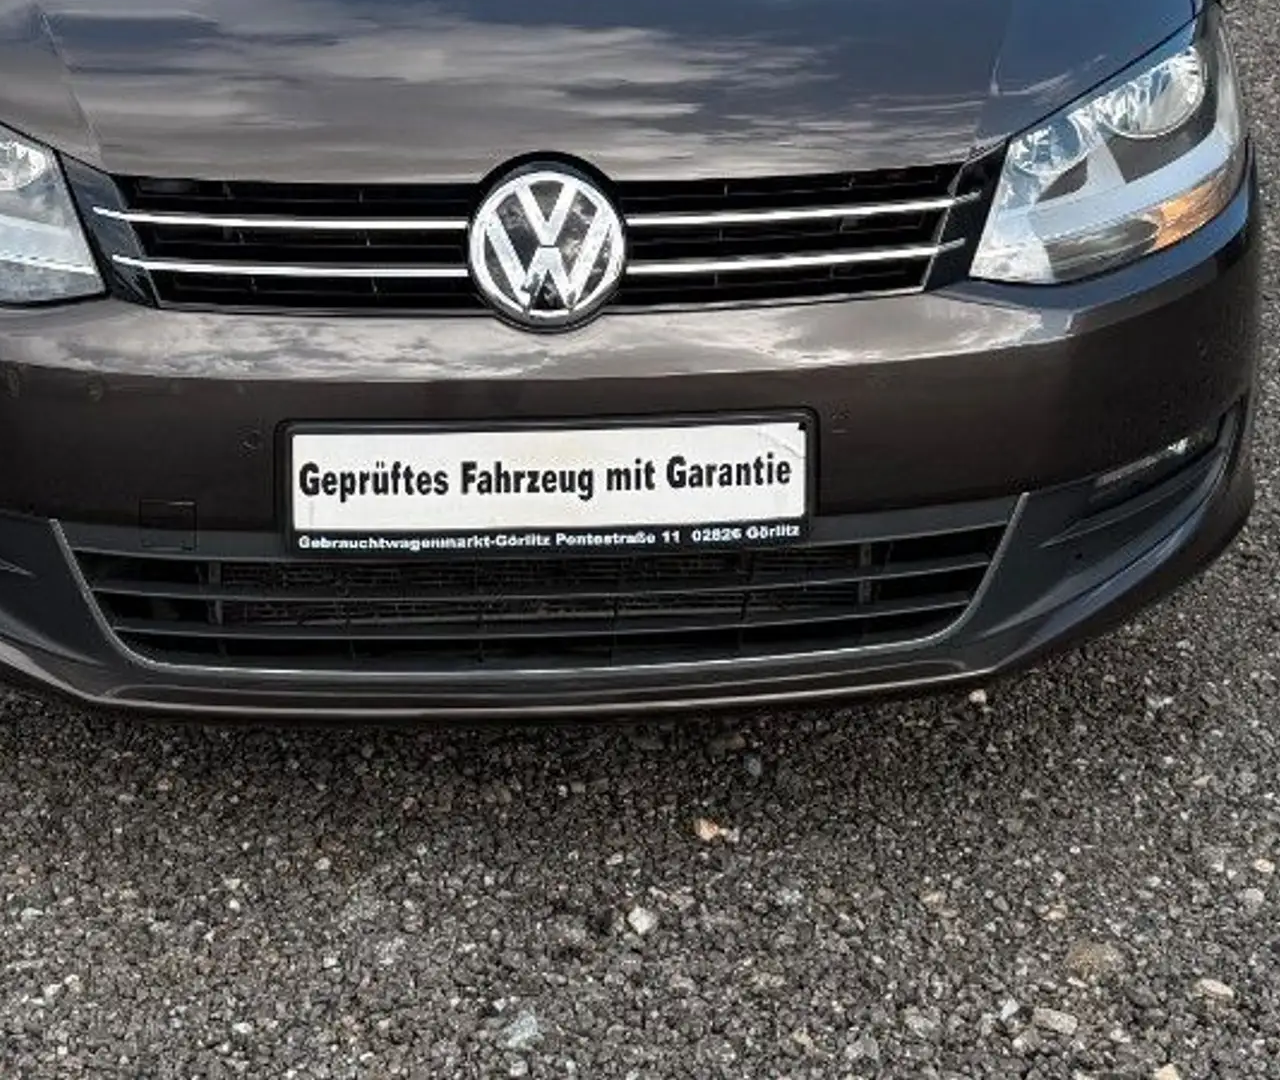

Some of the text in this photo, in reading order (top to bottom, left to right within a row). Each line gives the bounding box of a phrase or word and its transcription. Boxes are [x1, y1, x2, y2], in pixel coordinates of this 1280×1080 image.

[471, 172, 624, 317] VW
[299, 452, 793, 503] Geprüftes Fahrzeug mit Garantie
[662, 530, 681, 544] 11
[692, 527, 742, 542] 02826
[746, 524, 800, 540] Görlitz
